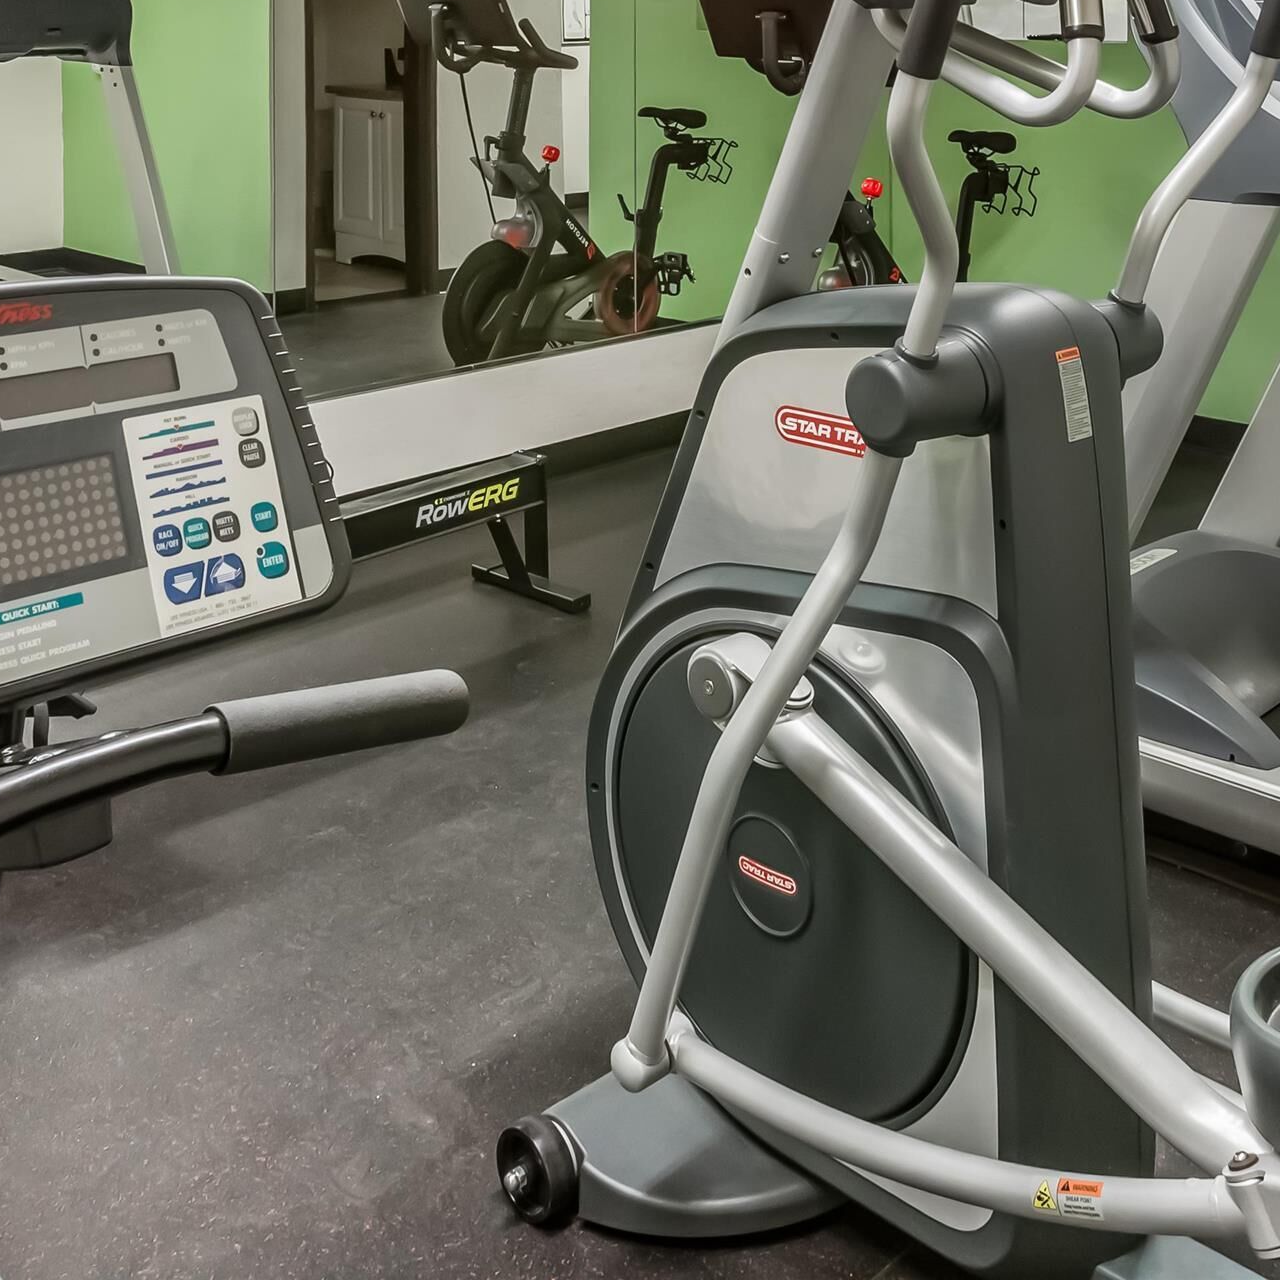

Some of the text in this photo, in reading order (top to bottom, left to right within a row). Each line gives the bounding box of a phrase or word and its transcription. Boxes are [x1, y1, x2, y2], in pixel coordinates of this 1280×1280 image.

[782, 417, 832, 438] STAR
[254, 510, 272, 522] START
[262, 554, 284, 568] ENTER
[1, 608, 31, 622] QUICK
